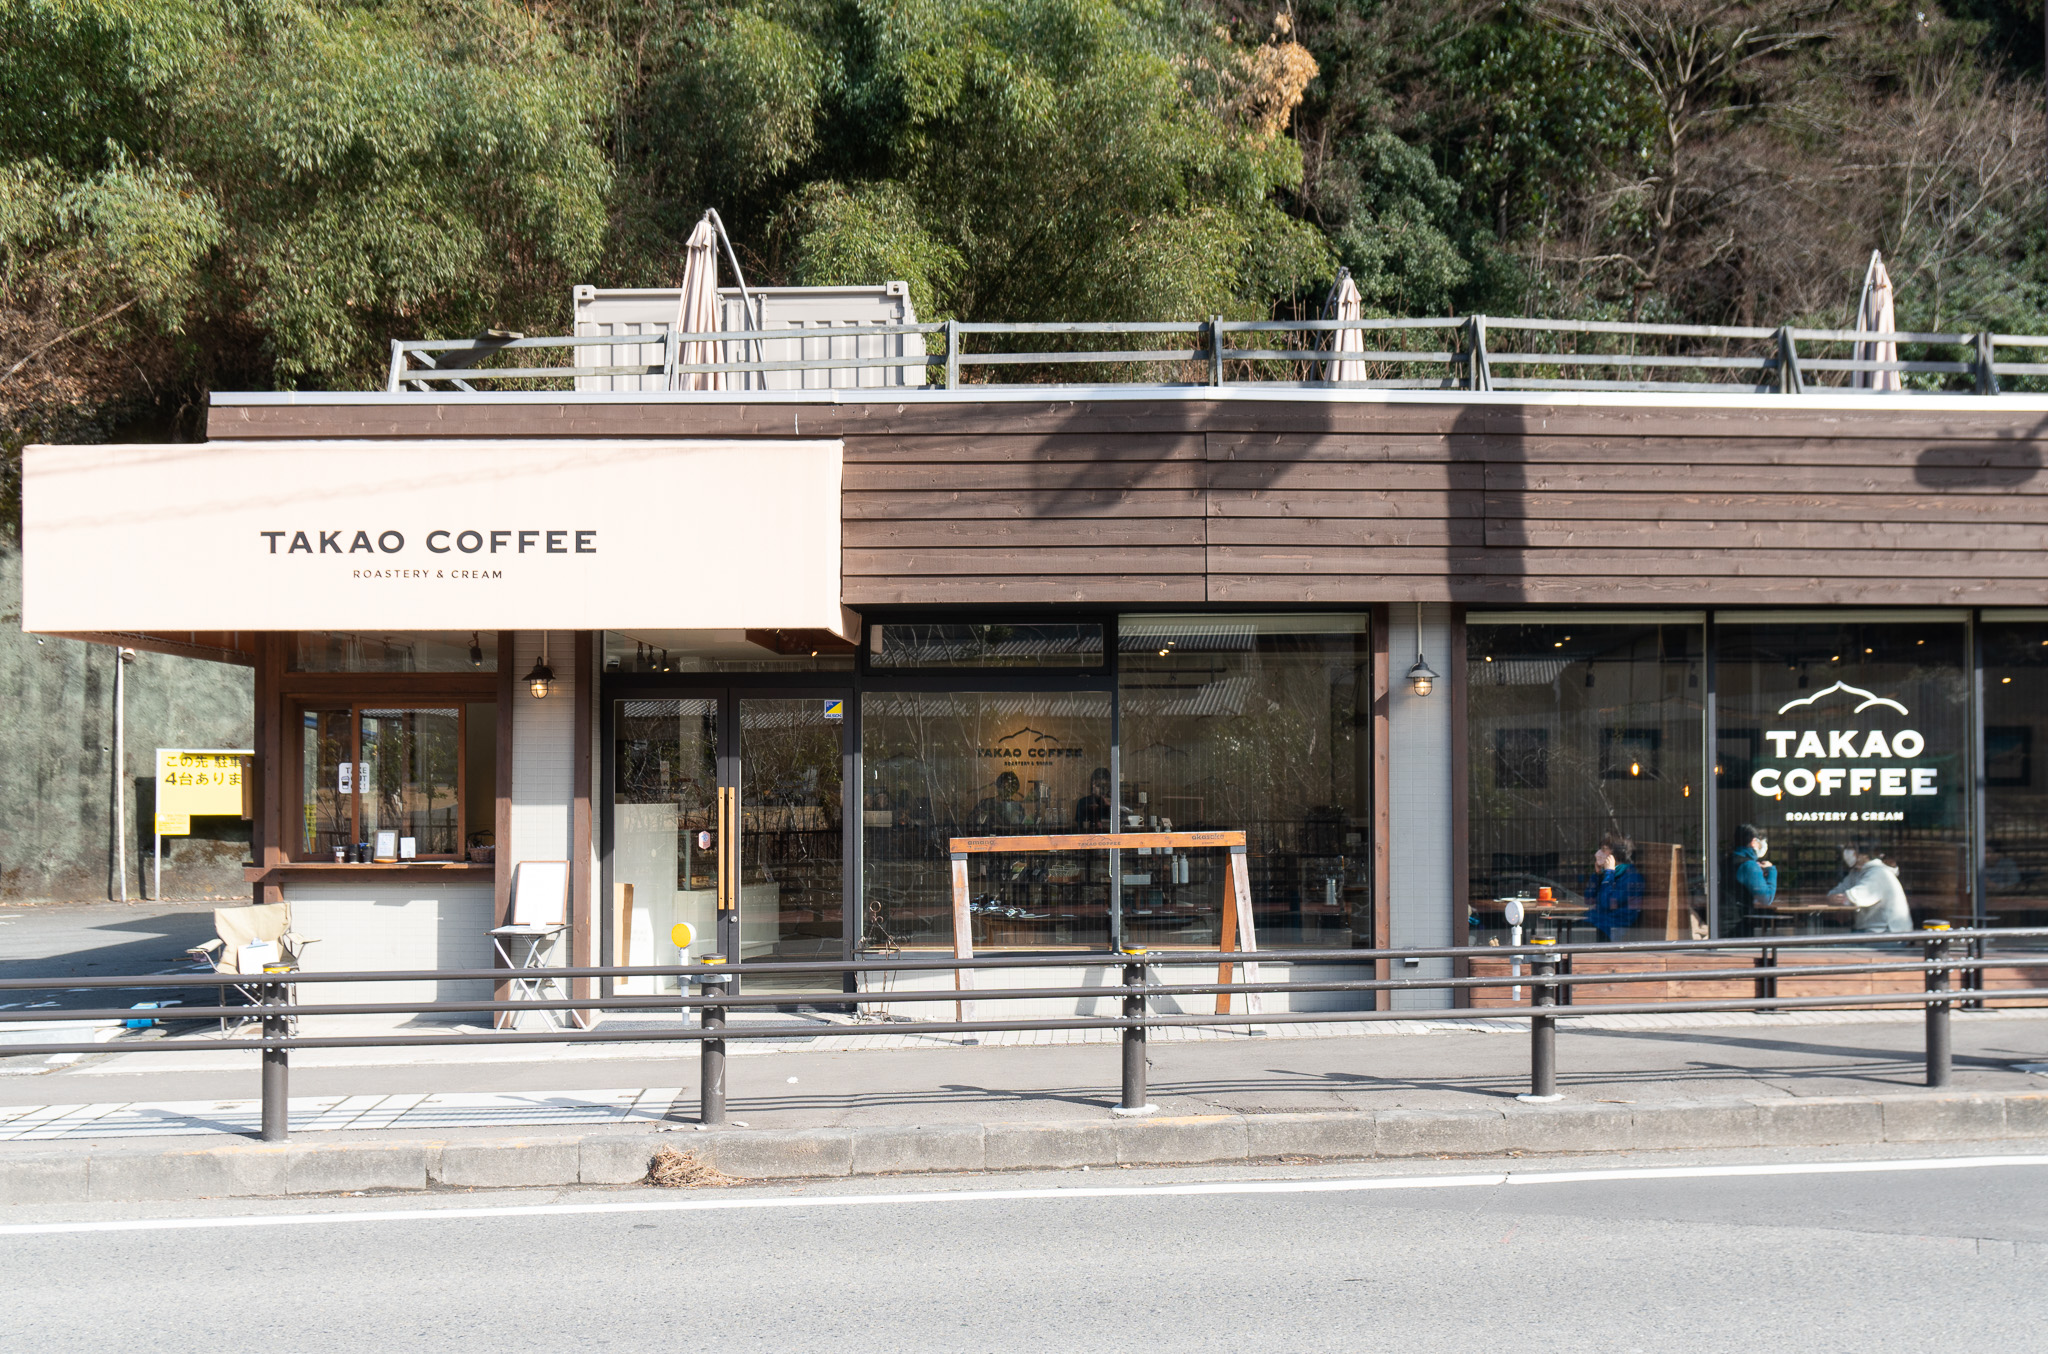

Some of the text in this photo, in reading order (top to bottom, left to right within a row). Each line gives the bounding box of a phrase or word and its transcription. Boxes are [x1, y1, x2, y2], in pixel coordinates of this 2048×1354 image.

[260, 530, 597, 554] TAKAO COFFEE
[353, 569, 502, 579] ROASTERY & CREAM
[1765, 729, 1925, 759] TAKAO
[977, 748, 1083, 758] TAKAO COFFEE
[166, 756, 208, 768] この先
[1750, 767, 1938, 797] COFFEE
[1785, 811, 1904, 822] ROASTERY & CREAM
